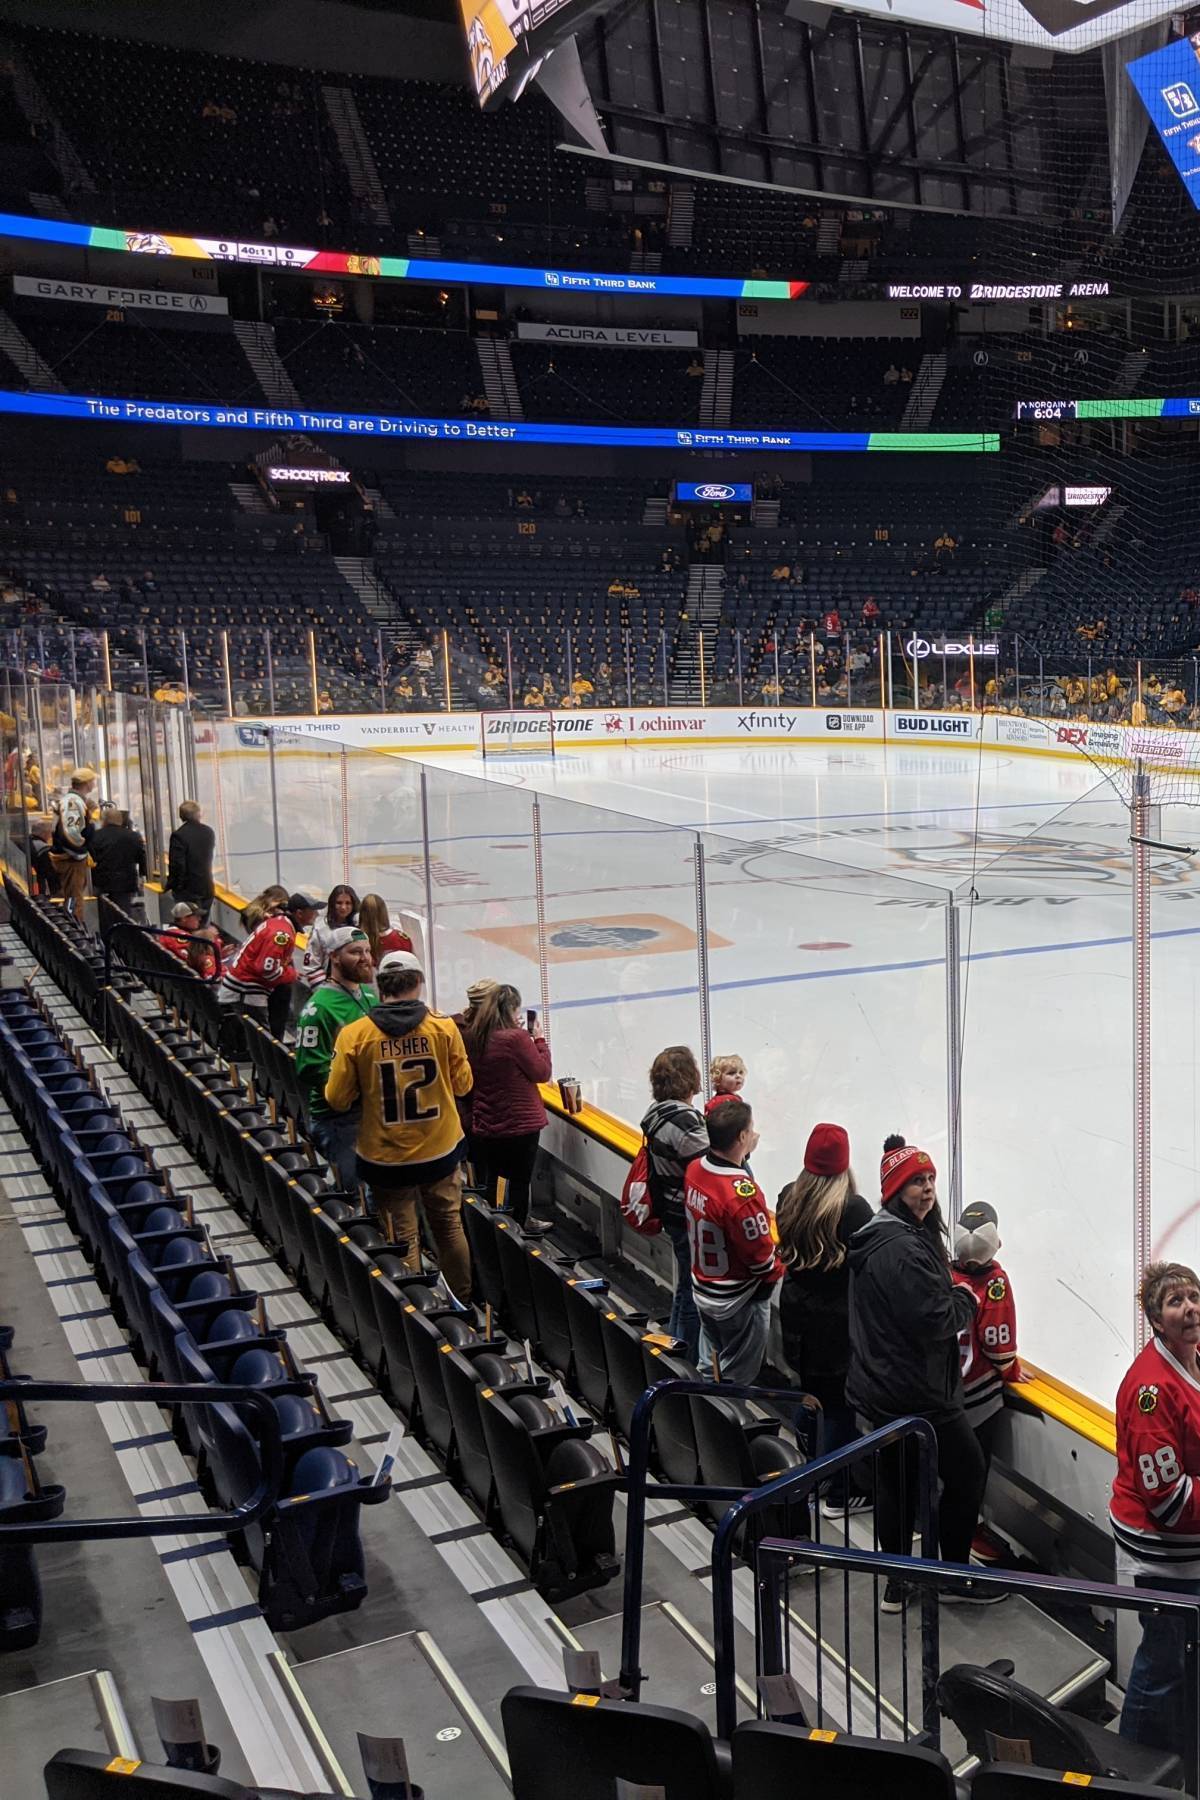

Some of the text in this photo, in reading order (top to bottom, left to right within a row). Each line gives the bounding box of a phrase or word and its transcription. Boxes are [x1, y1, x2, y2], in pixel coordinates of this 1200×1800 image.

[1163, 123, 1182, 137] FIFTH
[219, 244, 228, 253] 0
[241, 247, 272, 256] 40:11
[285, 250, 294, 259] 0
[562, 276, 656, 290] FIFTH THIRD BANK
[37, 282, 185, 308] GARY FORCE
[889, 283, 1109, 299] WELCOME TO BRIDGESTONE ARENA
[107, 310, 125, 322] 201
[545, 328, 672, 344] ACURA LEVEL
[88, 400, 517, 439] The Predators and Fifth Third are Driving to Better
[1034, 408, 1061, 419] 6:04
[695, 434, 791, 447] FIFTH THIRD BANK
[702, 486, 728, 497] Ford
[125, 510, 141, 523] 101
[518, 523, 536, 534] 120
[875, 529, 889, 541] 119
[932, 643, 1000, 655] LEXUS
[628, 716, 706, 732] Lochinvar
[737, 711, 797, 732] xfinity
[843, 713, 874, 723] DOWNLOAD
[306, 723, 341, 732] THIRD
[361, 724, 474, 735] VANDERBILT HEALTH
[487, 718, 594, 734] BRIDGESTONE
[843, 722, 866, 732] THE APP
[898, 717, 970, 733] BUD LIGHT
[1056, 727, 1088, 745] DEX
[1091, 731, 1119, 741] imaging
[1131, 744, 1183, 757] PREDATORS
[264, 959, 281, 972] 81
[381, 1037, 429, 1058] FISHER
[373, 1057, 441, 1126] 12
[687, 1186, 709, 1216] KANE
[742, 1212, 770, 1241] 88
[984, 1324, 1010, 1346] 88
[1138, 1445, 1180, 1490] 88
